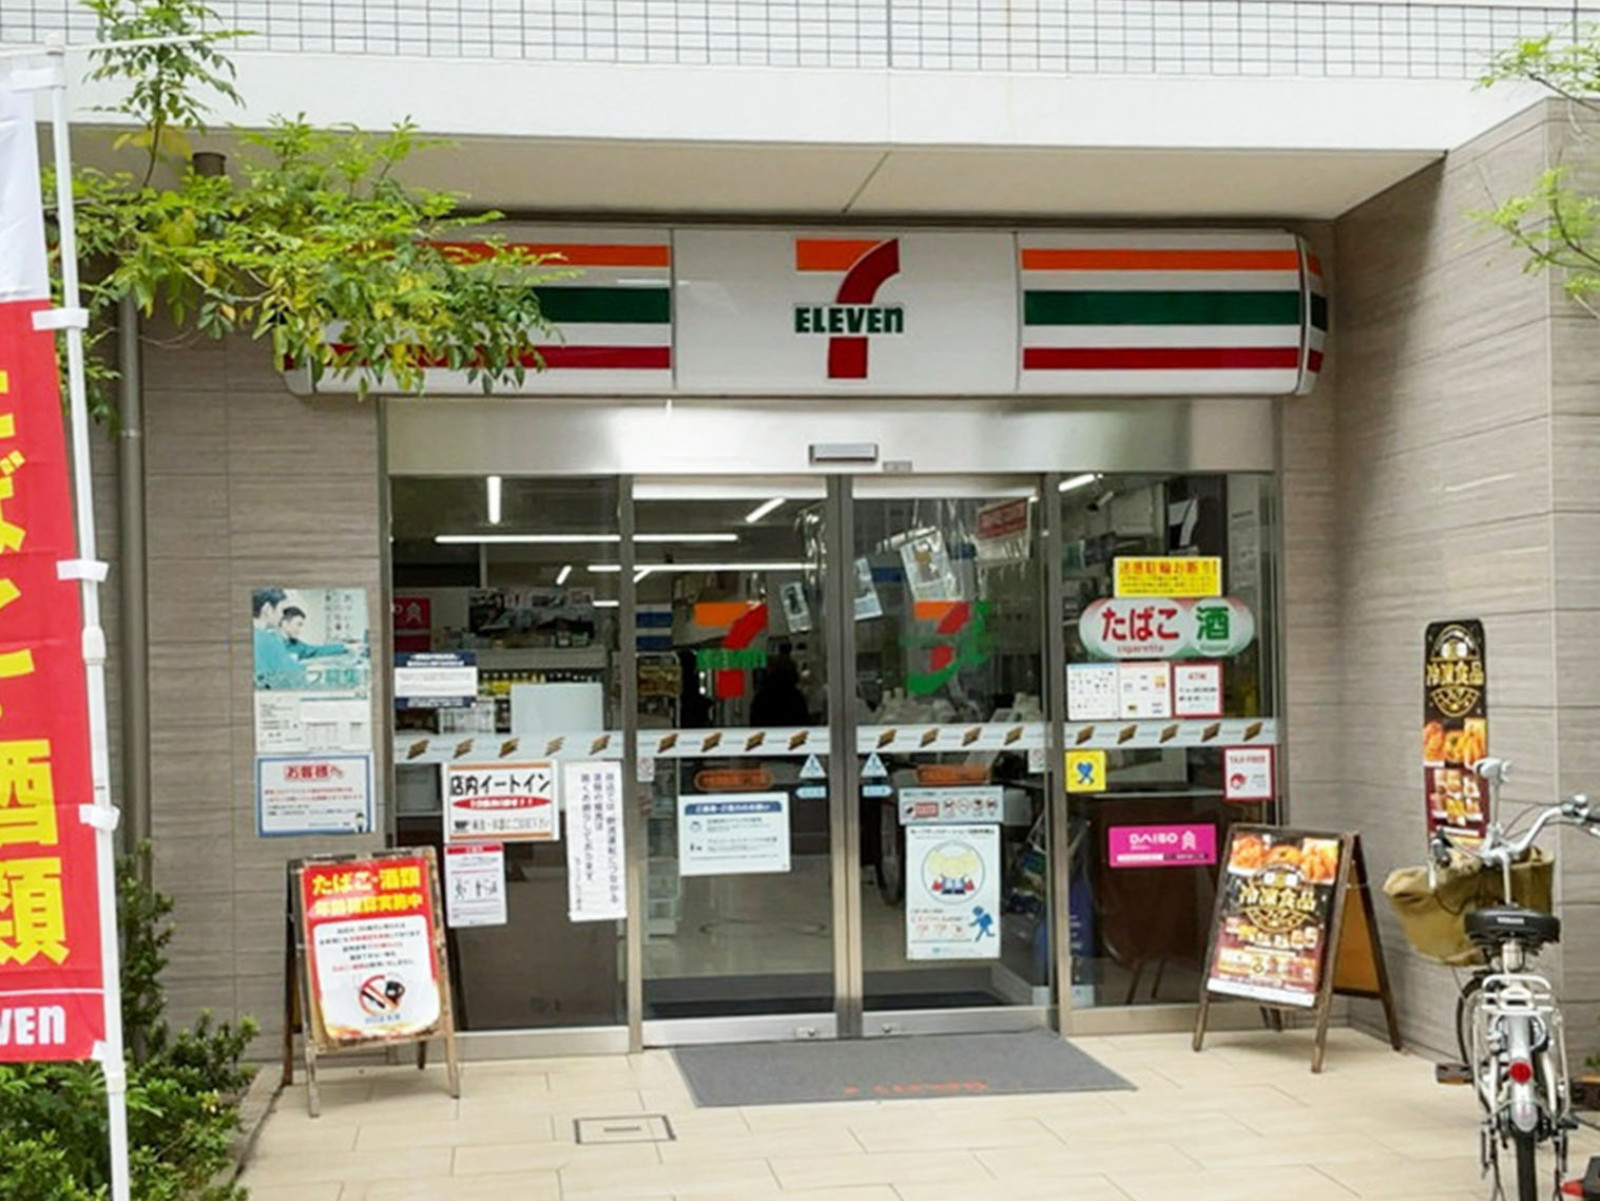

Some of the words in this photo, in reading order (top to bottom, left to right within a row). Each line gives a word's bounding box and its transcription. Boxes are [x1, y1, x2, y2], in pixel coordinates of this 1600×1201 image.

[795, 238, 900, 379] 7
[1101, 606, 1180, 641] たばこ
[1196, 606, 1229, 640] 酒
[286, 765, 344, 779] お客様へ
[450, 773, 551, 796] 店内イートイン
[1129, 832, 1178, 845] DAISO
